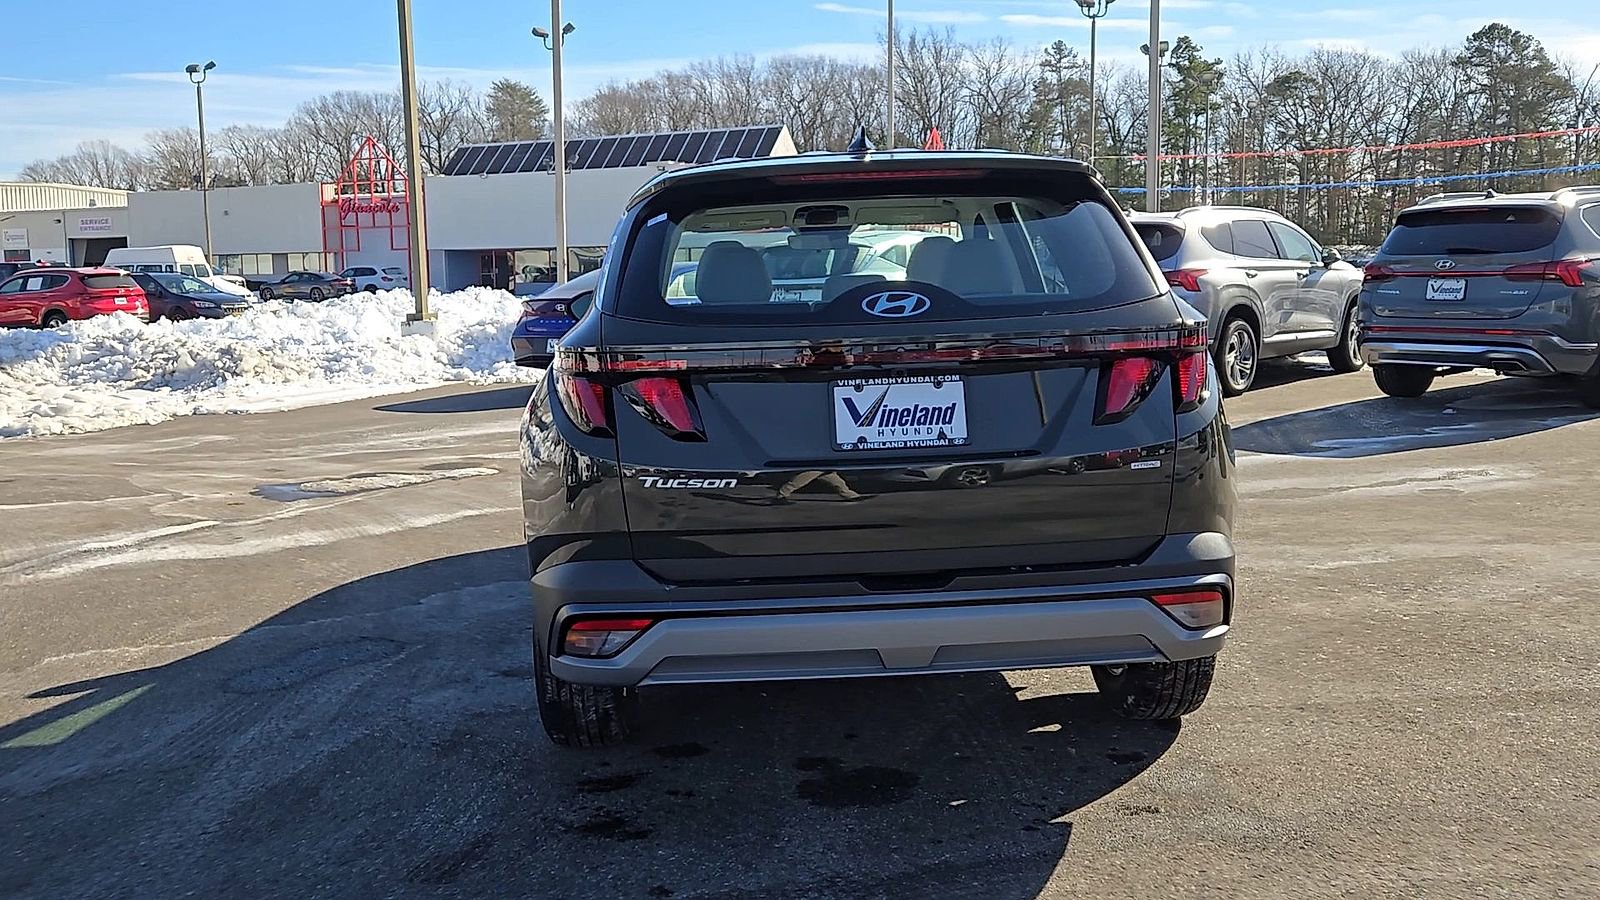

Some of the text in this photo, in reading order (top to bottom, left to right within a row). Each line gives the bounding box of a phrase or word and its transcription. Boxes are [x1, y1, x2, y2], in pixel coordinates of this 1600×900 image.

[837, 374, 960, 386] VINELANDHYUNDAI.COM
[842, 384, 957, 428] Vineland
[877, 426, 954, 437] HYUNDAI
[857, 439, 949, 449] VINELAND HYUNDAI
